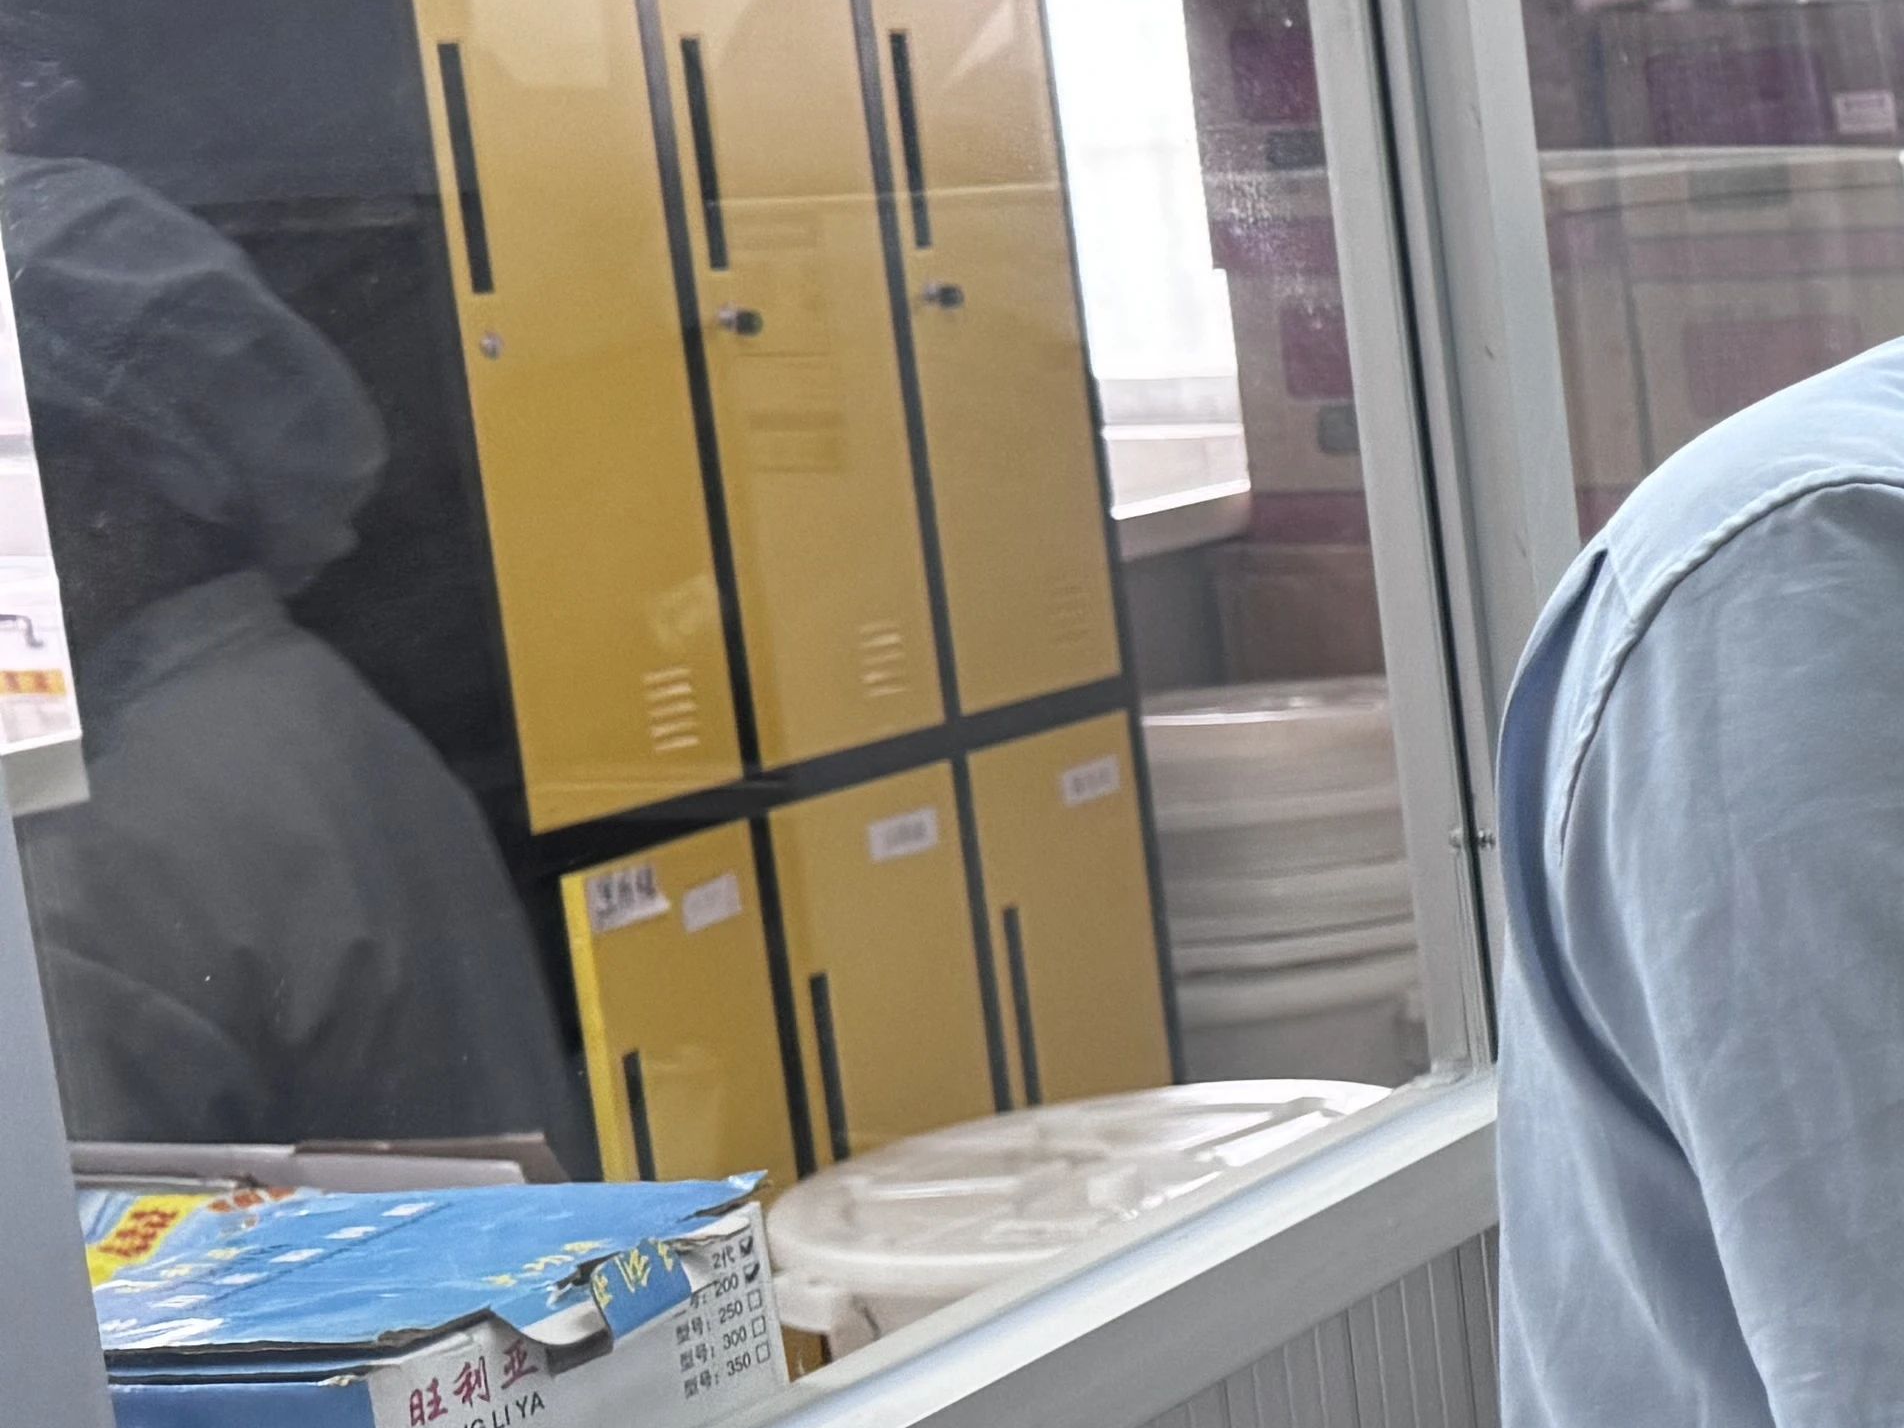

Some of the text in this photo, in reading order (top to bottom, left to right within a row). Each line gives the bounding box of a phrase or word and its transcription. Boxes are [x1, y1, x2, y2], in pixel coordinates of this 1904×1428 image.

[714, 1273, 740, 1299] 200
[718, 1301, 744, 1325] 250
[723, 1327, 748, 1351] 300
[727, 1353, 752, 1379] 350
[408, 1339, 540, 1427] 旺利亚
[514, 1390, 546, 1420] YA
